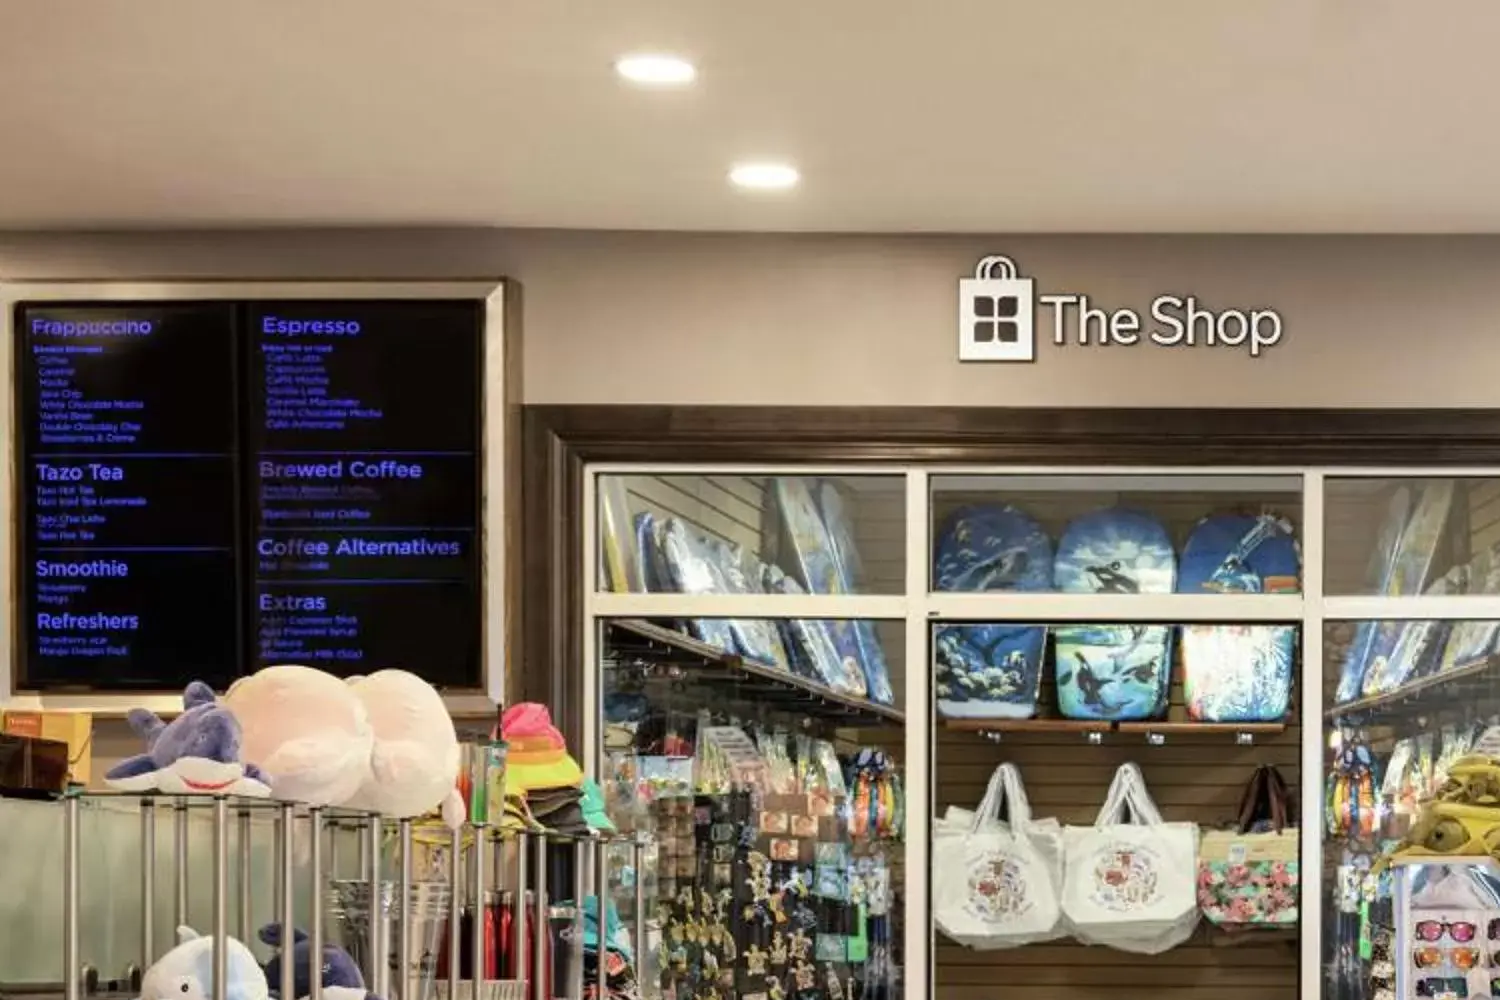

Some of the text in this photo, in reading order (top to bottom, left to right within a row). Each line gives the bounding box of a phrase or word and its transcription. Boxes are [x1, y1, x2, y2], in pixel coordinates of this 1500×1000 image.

[32, 319, 152, 336] Frappuccino
[262, 316, 361, 336] Espresso
[1040, 295, 1282, 356] The Shop
[36, 463, 124, 480] Tazo Tea
[259, 460, 423, 478] Brewed Coffee
[258, 538, 460, 556] Coffee Alternatives
[36, 559, 129, 577] Smoothie
[259, 593, 327, 611] Extras
[37, 612, 139, 629] Refreshers
